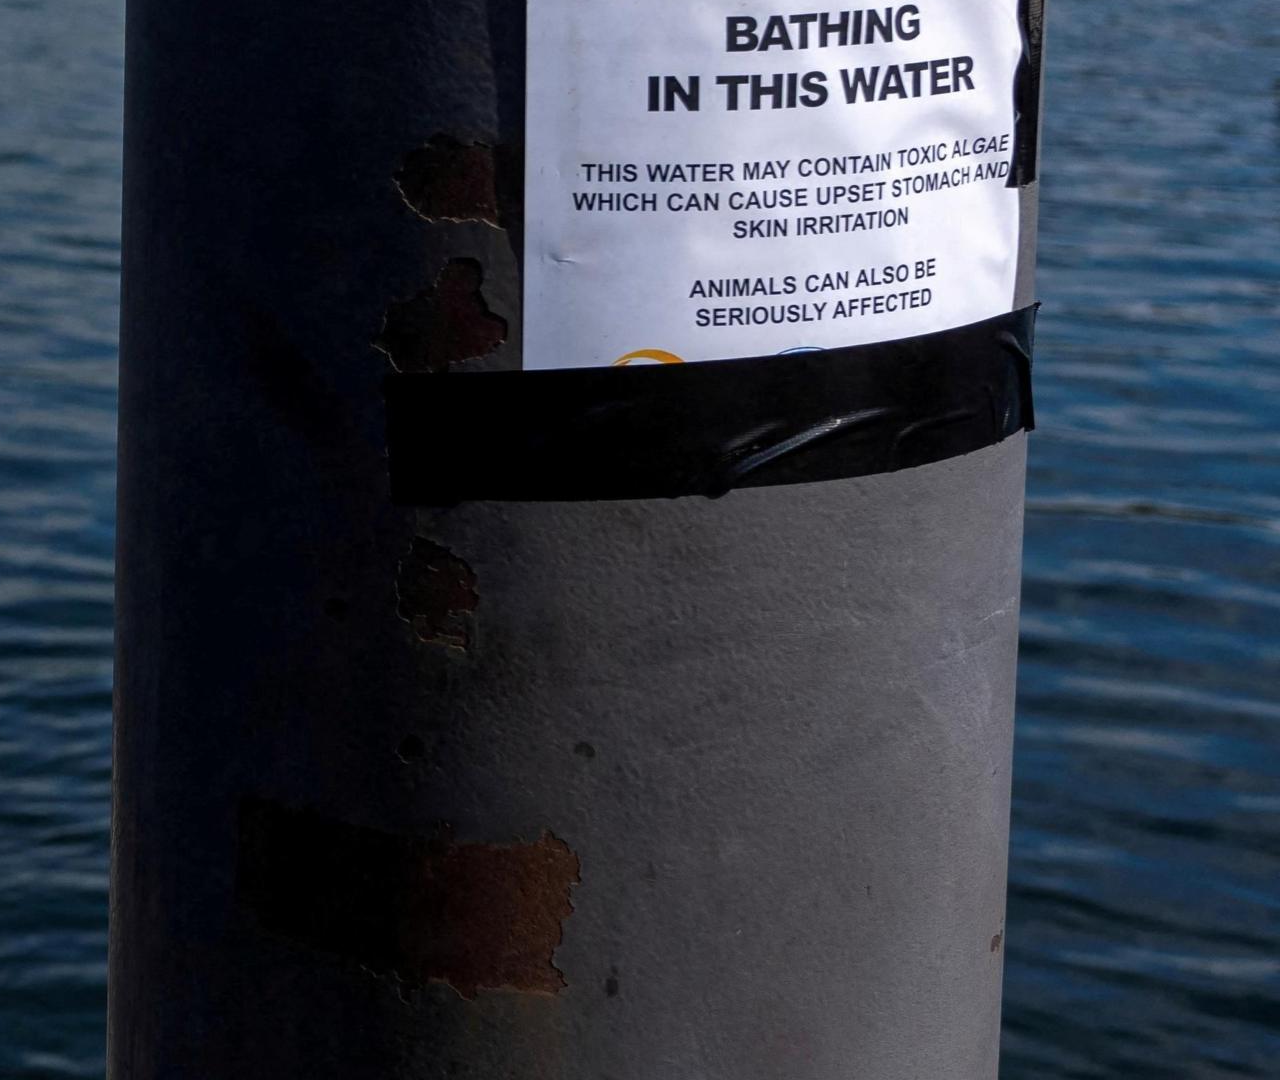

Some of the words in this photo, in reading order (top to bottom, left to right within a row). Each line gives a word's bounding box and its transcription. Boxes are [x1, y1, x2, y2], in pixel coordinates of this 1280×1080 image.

[726, 5, 920, 52] BATHING
[648, 76, 699, 111] IN
[716, 71, 828, 110] THIS
[840, 56, 974, 104] WATER
[581, 164, 637, 182] THIS
[646, 164, 734, 182] WATER
[744, 160, 790, 180] MAY
[798, 153, 891, 177] CONTAIN
[898, 143, 946, 167] TOXIC
[952, 134, 1009, 158] ALGAE
[573, 193, 656, 211] WHICH
[667, 193, 718, 211] CAN
[729, 189, 807, 210] CAUSE
[817, 182, 886, 205] UPSET
[892, 167, 969, 197] STOMACH
[974, 161, 1009, 186] AND
[733, 219, 787, 238] SKIN
[797, 207, 908, 235] IRRITATION
[690, 276, 796, 298] ANIMALS
[805, 271, 848, 292] CAN
[856, 264, 908, 287] ALSO
[915, 259, 935, 279] BE
[696, 303, 827, 326] SERIOUSLY
[833, 288, 931, 319] AFFECTED
